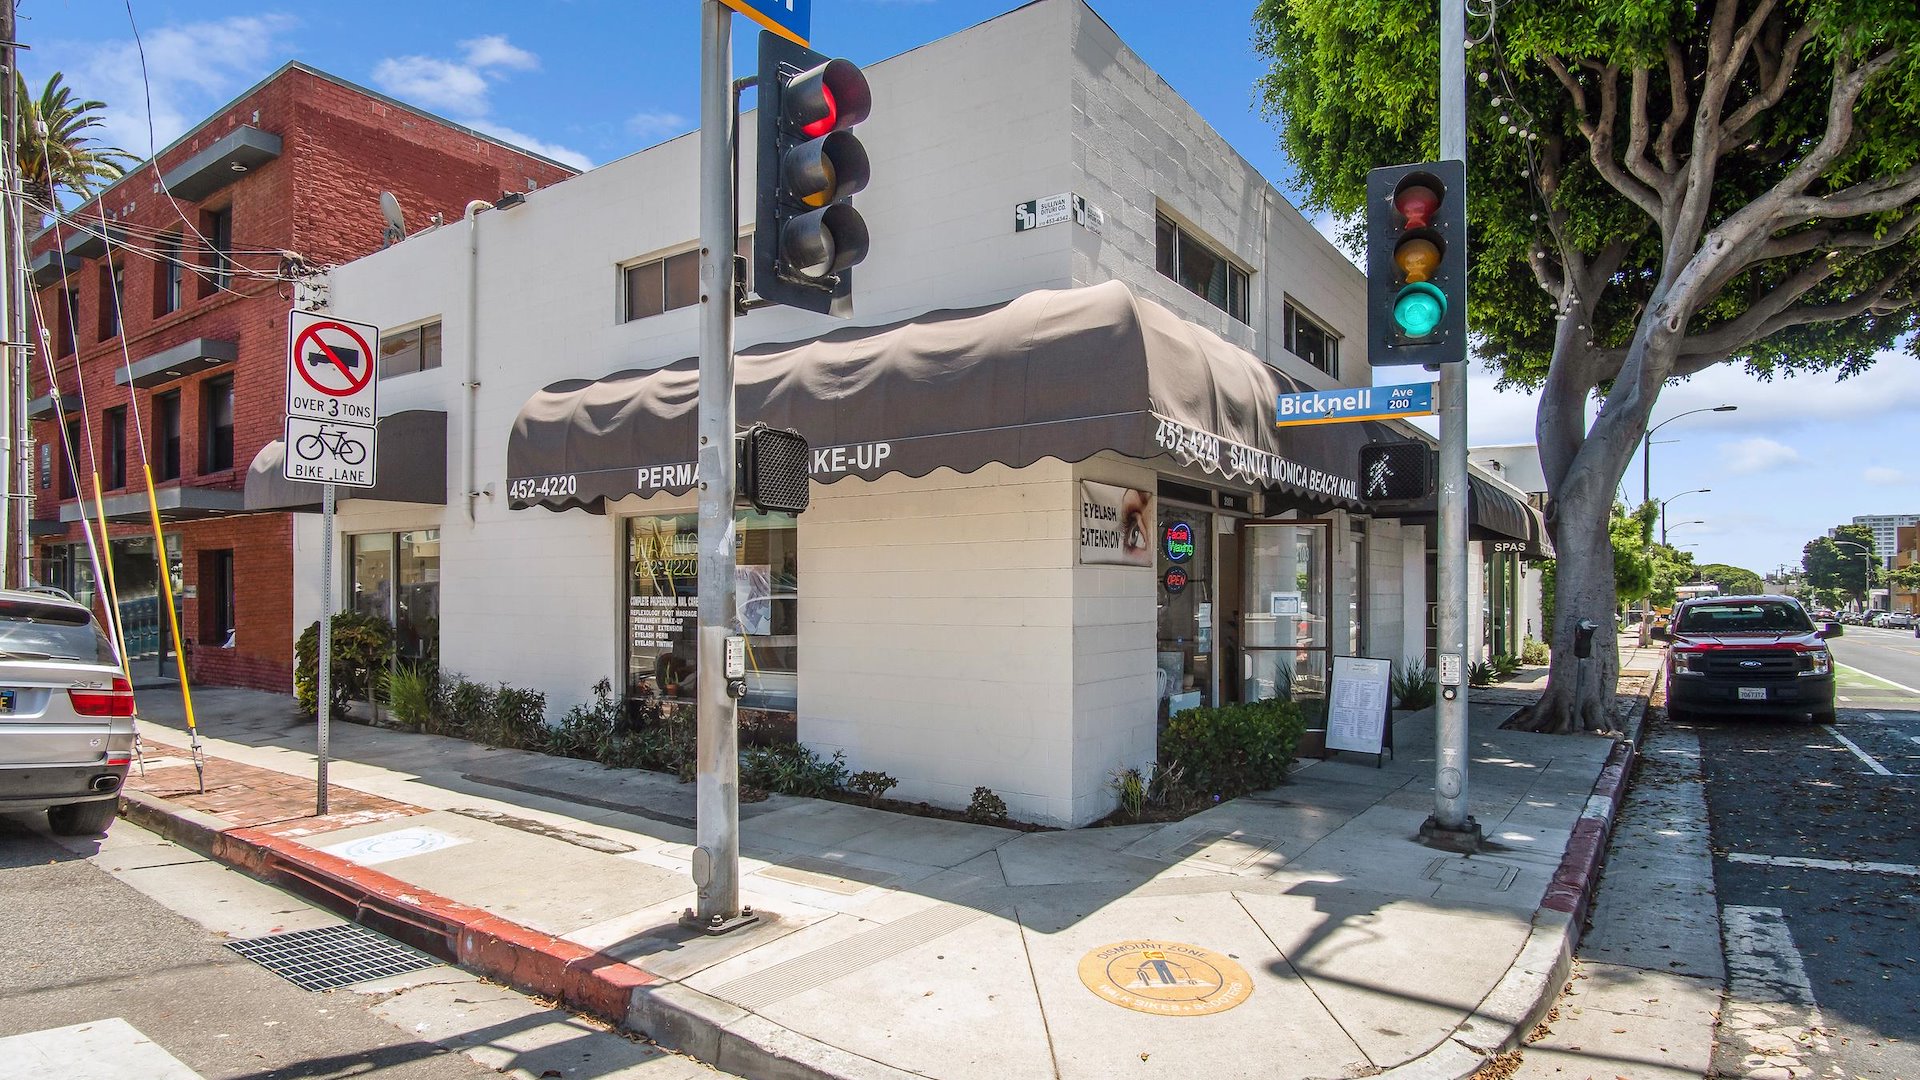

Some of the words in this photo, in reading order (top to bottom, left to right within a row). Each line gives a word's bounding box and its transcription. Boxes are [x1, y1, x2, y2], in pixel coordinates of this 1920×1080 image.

[1392, 388, 1414, 398] Ave
[294, 397, 325, 412] OVER
[328, 398, 339, 417] 3
[342, 403, 371, 418] TONS
[1281, 390, 1371, 415] Bicknell
[1389, 399, 1409, 409] 200
[1155, 420, 1220, 464] 452-4220
[1230, 444, 1269, 478] SANTA
[1271, 457, 1308, 487] MONICA
[1309, 470, 1339, 497] BEACH
[295, 464, 324, 479] BIKE
[334, 468, 365, 483] LANE
[509, 474, 577, 499] 452-4220
[1084, 502, 1117, 522] EYELASH
[1081, 527, 1121, 549] EXTENSION
[1166, 528, 1188, 541] Facial
[634, 532, 698, 559] WAXING
[1169, 541, 1194, 556] Waxing
[1494, 542, 1526, 552] SPAS
[634, 558, 698, 577] 452-4220
[1167, 575, 1186, 586] OPEN
[630, 596, 650, 607] COMPLETE
[650, 596, 677, 607] PROFESSIONAL
[630, 609, 660, 617] REFLEXOLOGY
[661, 609, 674, 617] FOOT
[675, 610, 698, 618] MASSAGE
[661, 617, 684, 625] MAKE-UP
[634, 639, 655, 647] EYELASH
[656, 640, 674, 648] TINTING
[1097, 943, 1162, 960] DISMOUNT
[1167, 945, 1209, 959] ZONE
[1192, 982, 1243, 1011] SCOOTERS
